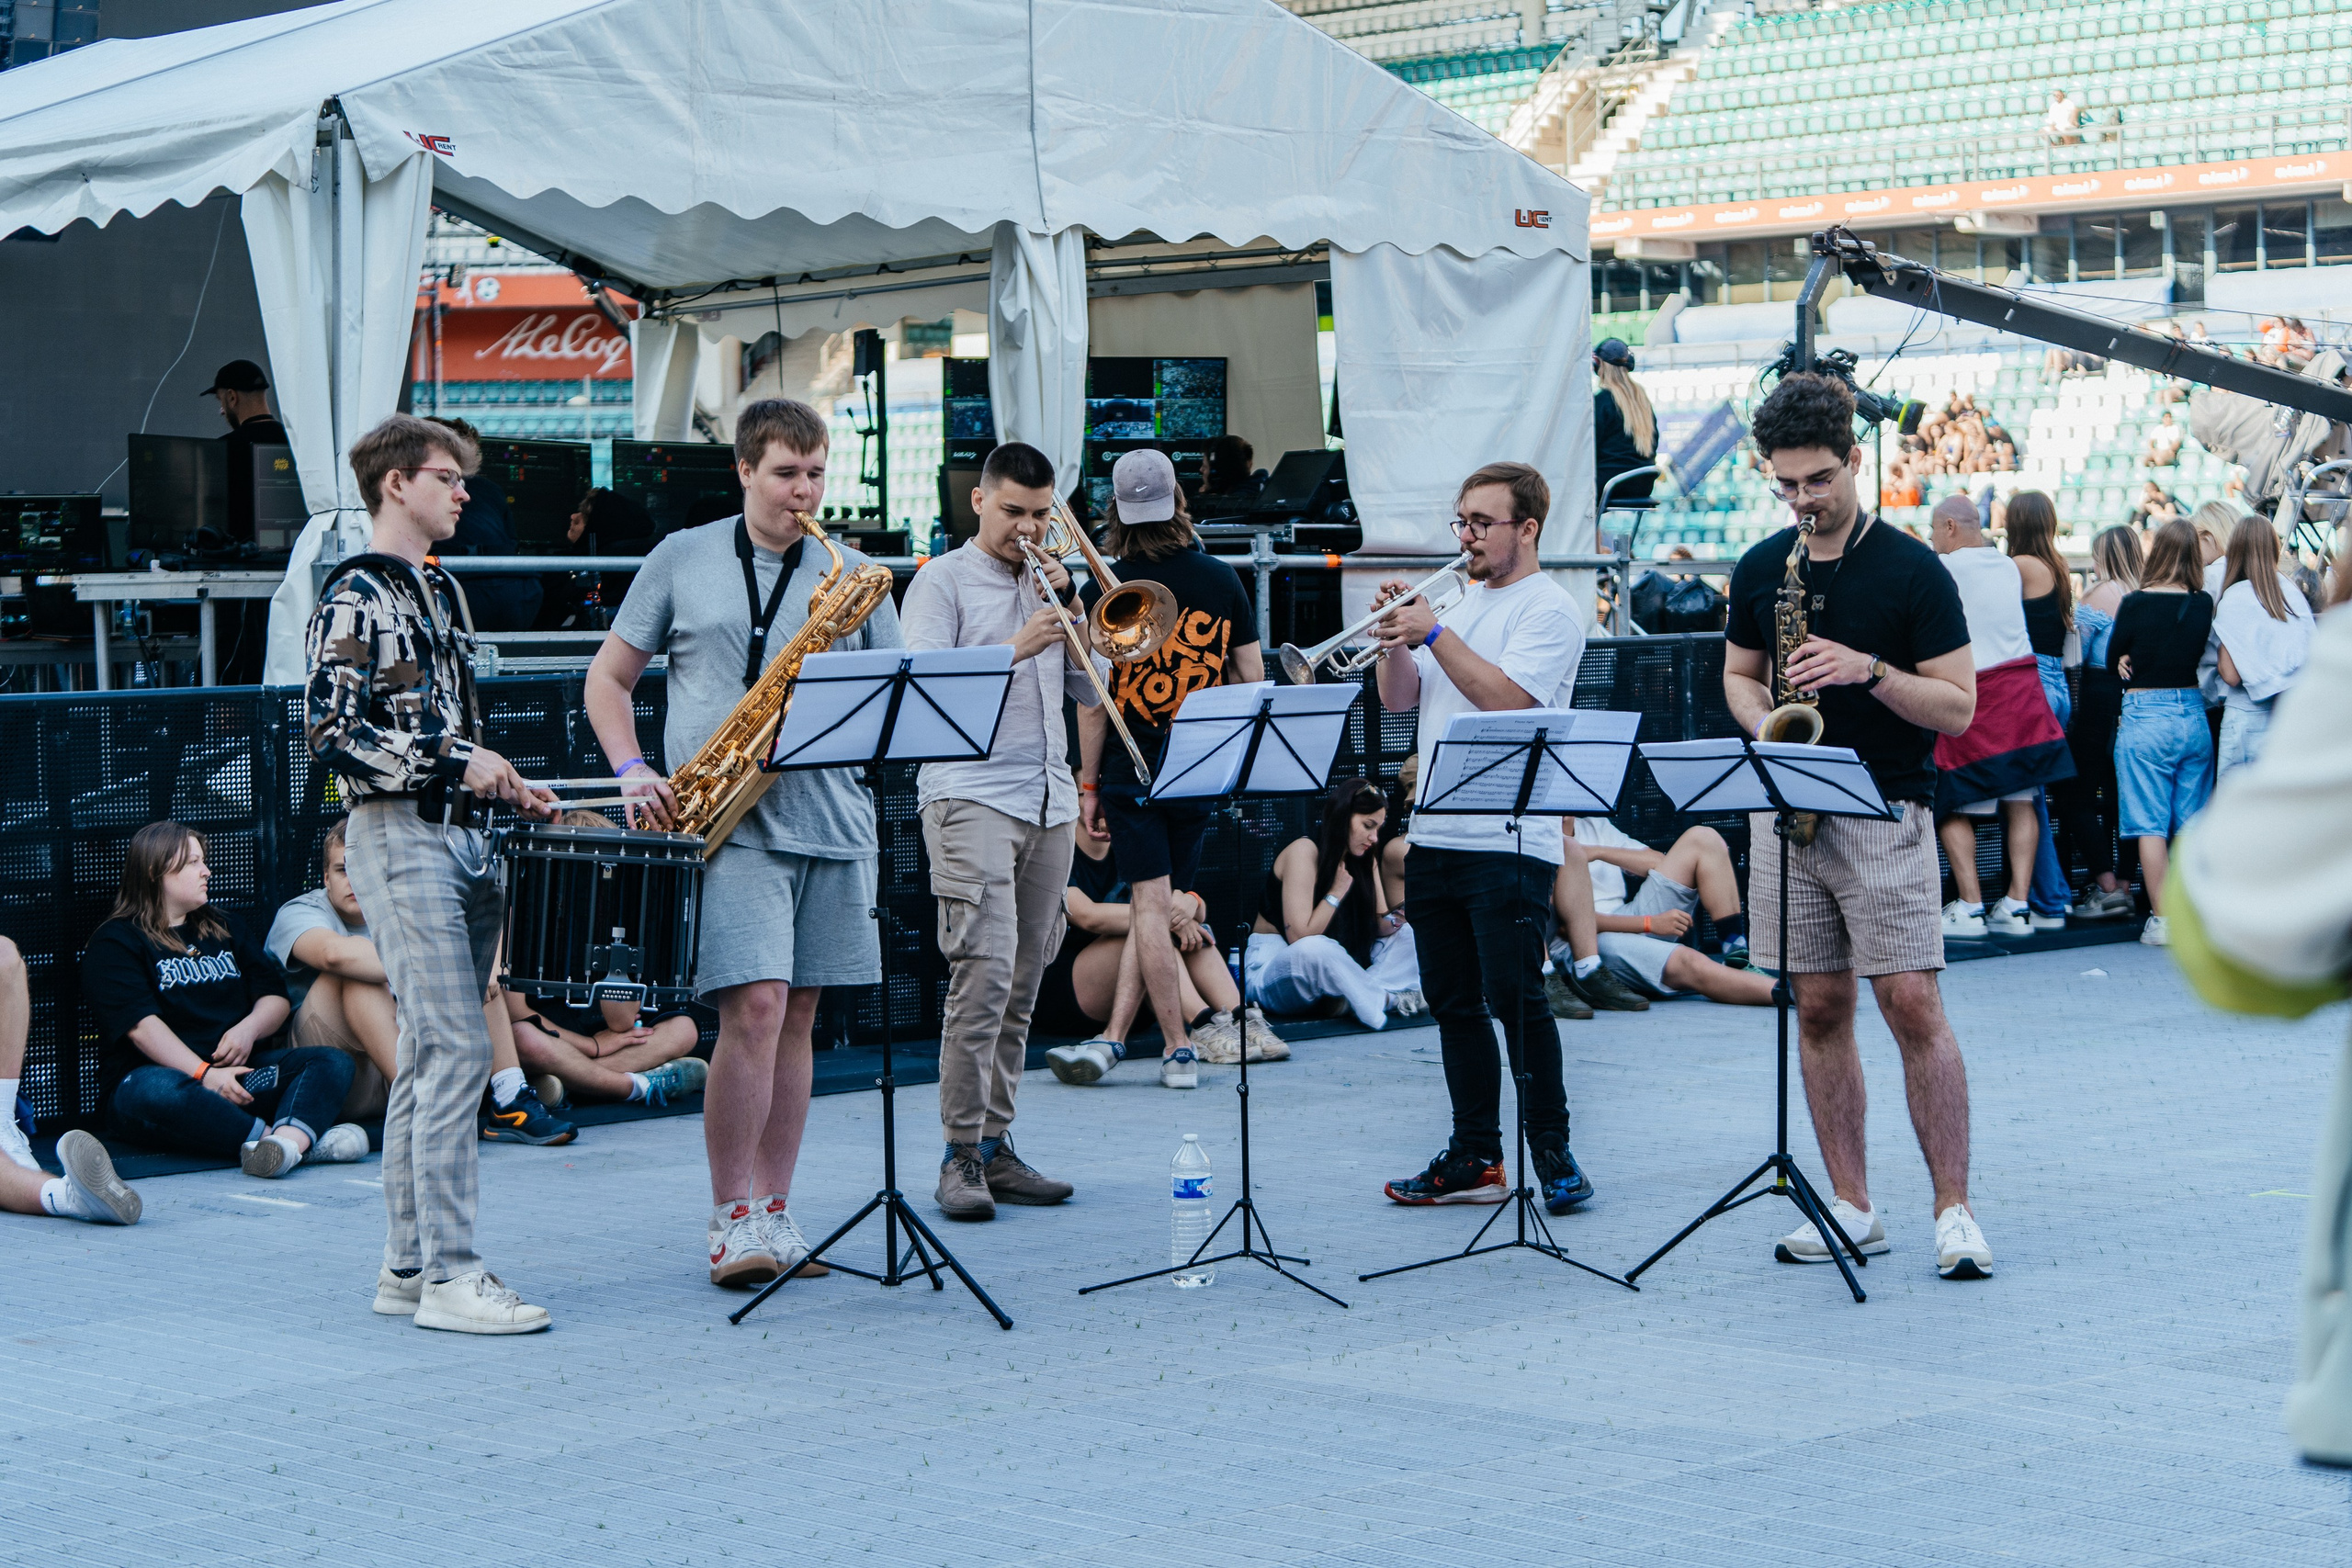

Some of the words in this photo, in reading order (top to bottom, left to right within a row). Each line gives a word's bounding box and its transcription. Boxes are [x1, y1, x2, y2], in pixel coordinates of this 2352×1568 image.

[437, 142, 457, 151] RENT
[1515, 209, 1549, 229] UC
[1175, 1050, 1191, 1058] NIKE
